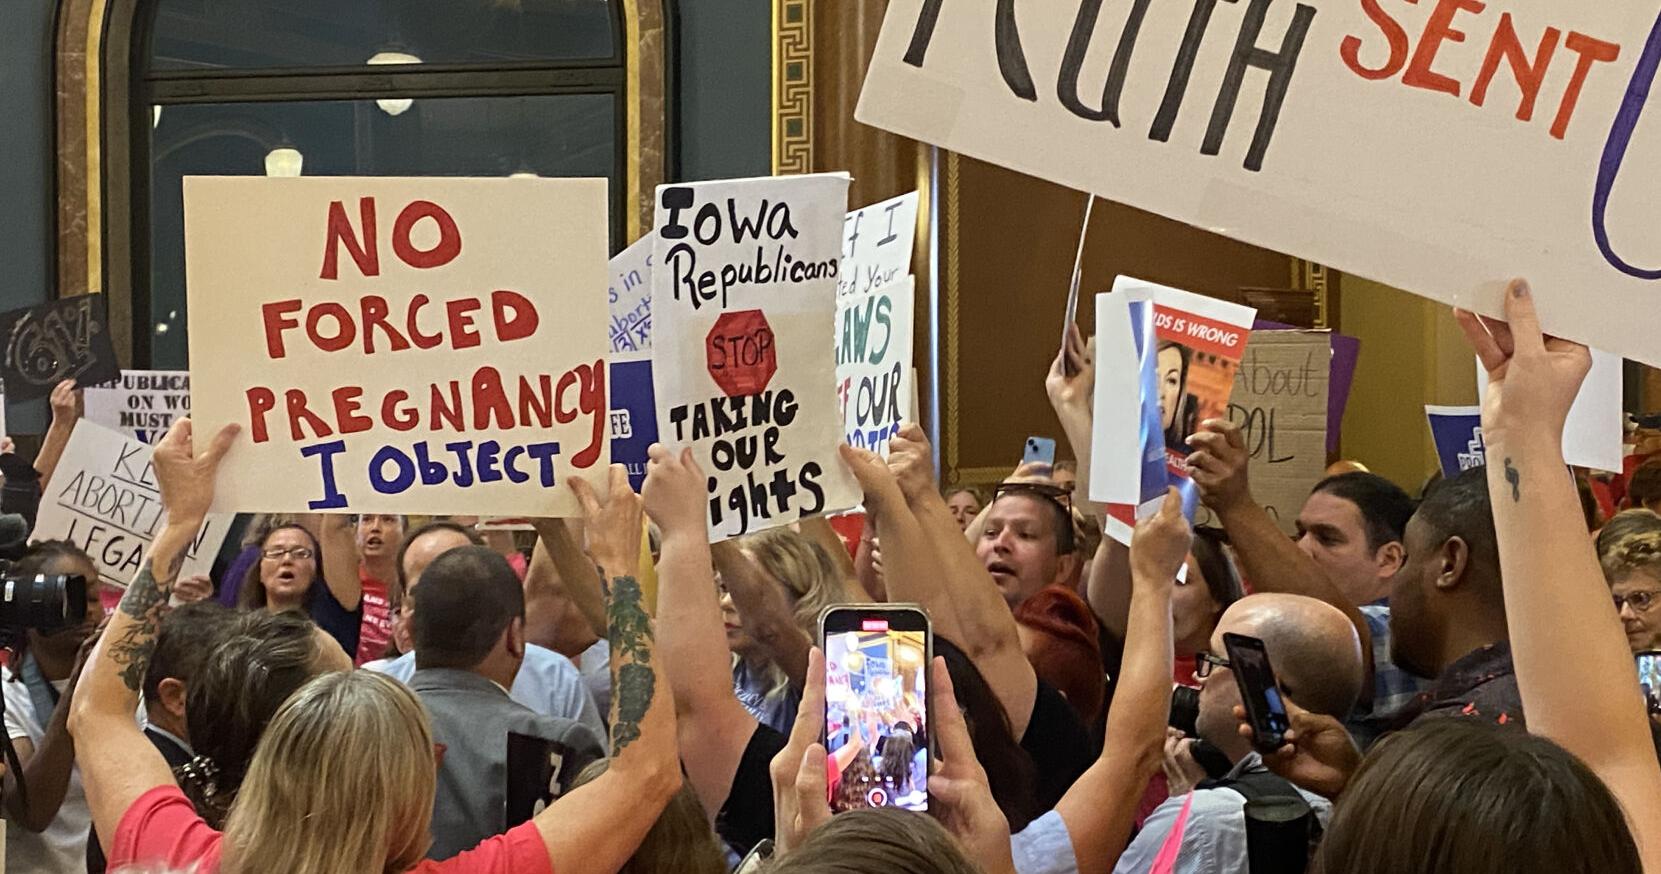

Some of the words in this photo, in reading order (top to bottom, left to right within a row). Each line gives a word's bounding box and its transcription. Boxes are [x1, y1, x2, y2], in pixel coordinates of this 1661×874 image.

[1340, 0, 1621, 140] SENT
[319, 197, 461, 280] NO
[877, 201, 903, 247] I
[620, 269, 642, 291] in
[665, 244, 838, 310] Republicans
[262, 290, 539, 358] FORCED
[712, 327, 771, 370] STOP
[1172, 318, 1187, 332] IS
[1187, 322, 1239, 347] WRONG
[93, 376, 189, 390] PUBLICA
[127, 395, 154, 409] ON
[857, 361, 902, 427] OUR
[120, 412, 172, 428] MUST
[246, 358, 605, 469] PREGNANCY
[670, 389, 798, 441] TAKING
[300, 439, 348, 510] I
[711, 426, 785, 471] OUR
[59, 470, 209, 555] ABORTIN
